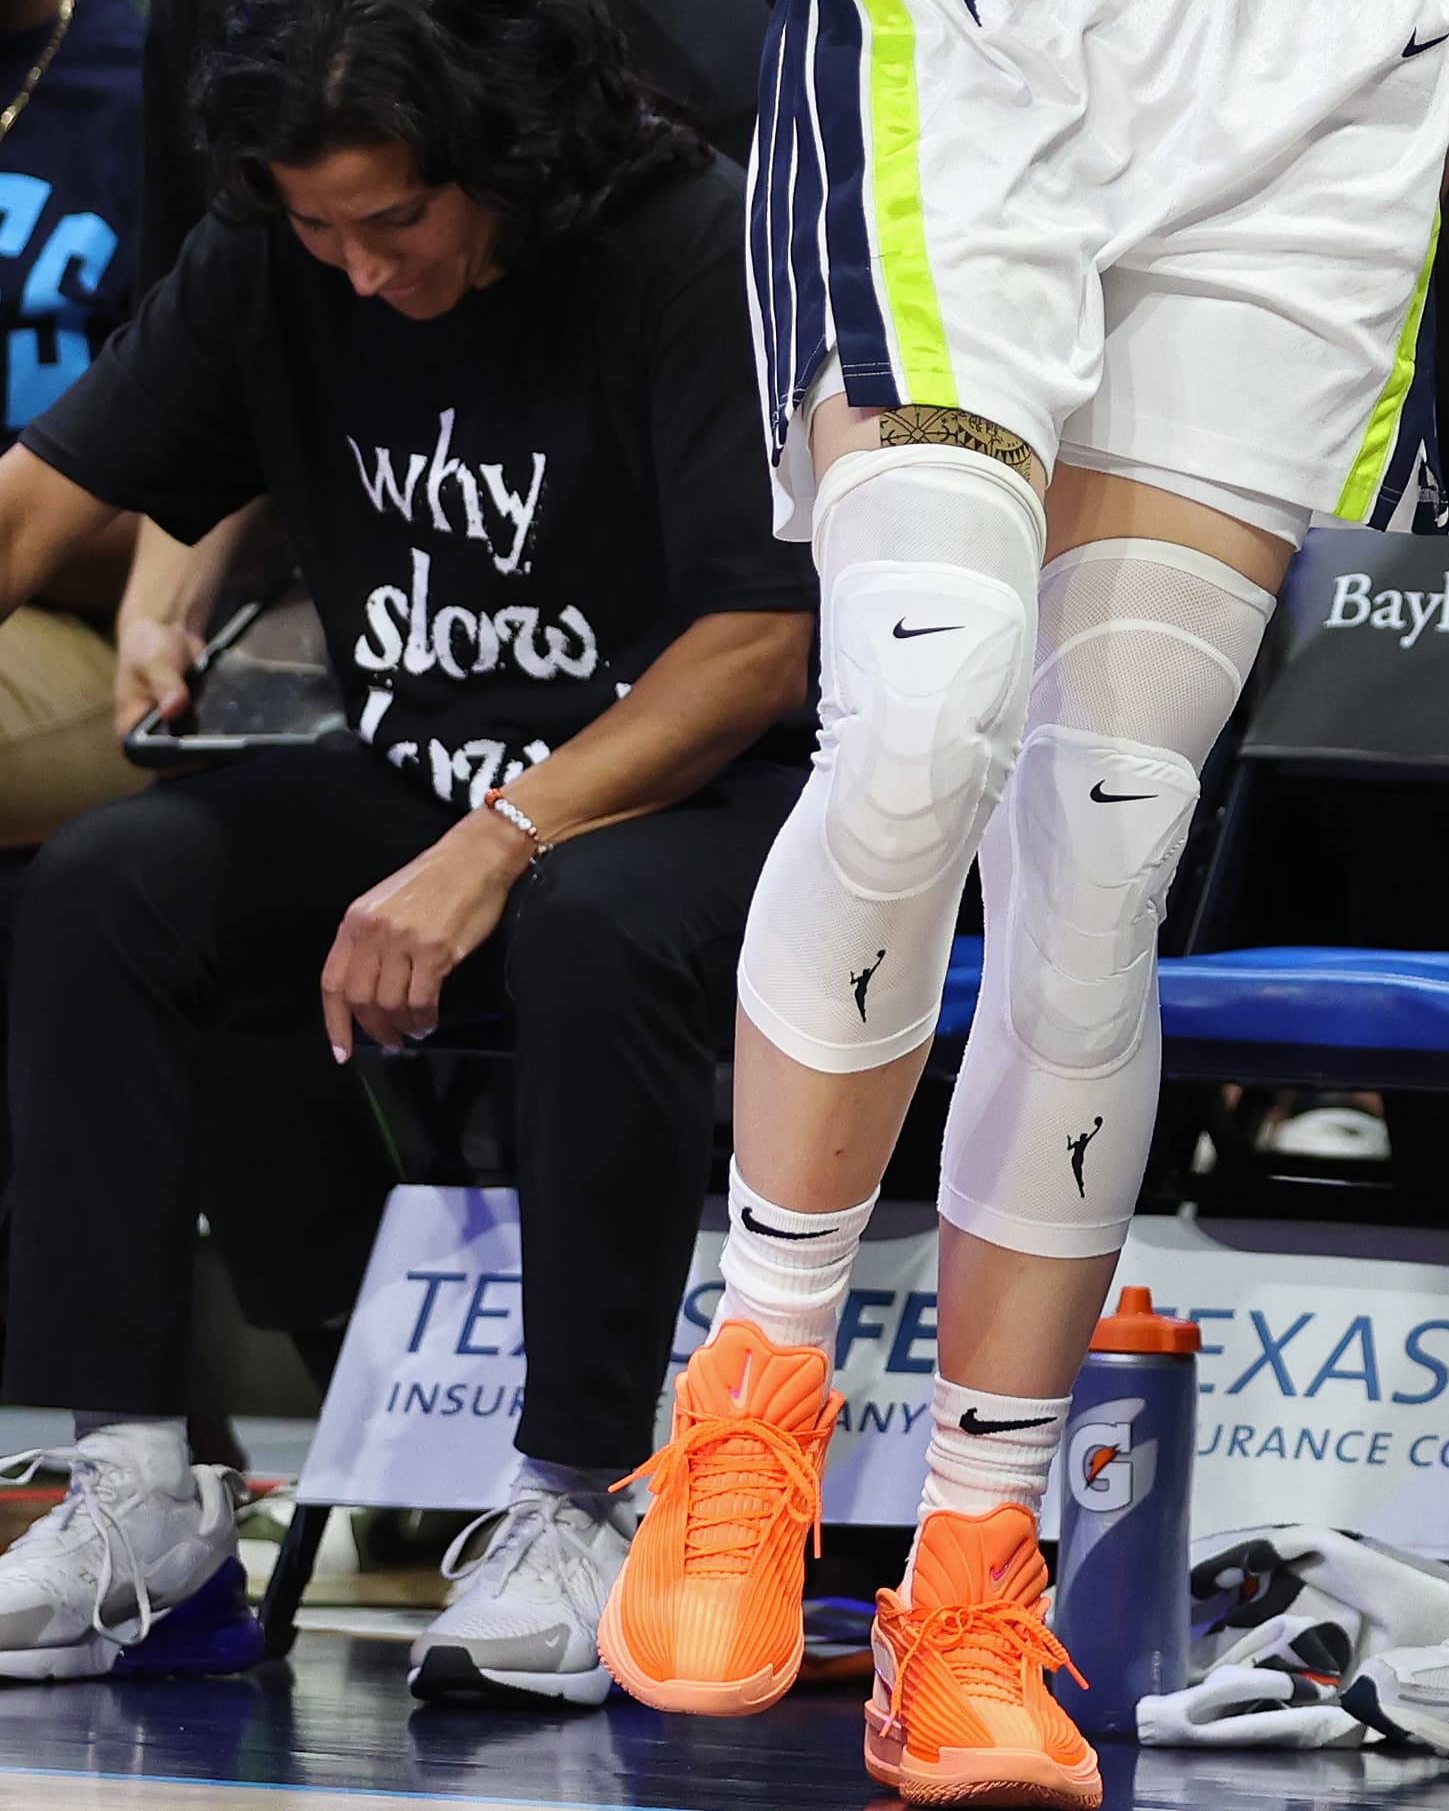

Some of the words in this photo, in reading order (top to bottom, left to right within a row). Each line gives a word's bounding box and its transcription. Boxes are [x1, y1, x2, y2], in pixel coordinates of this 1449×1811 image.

[347, 408, 546, 574] why
[354, 547, 598, 680] slow
[1068, 1421, 1133, 1512] G
